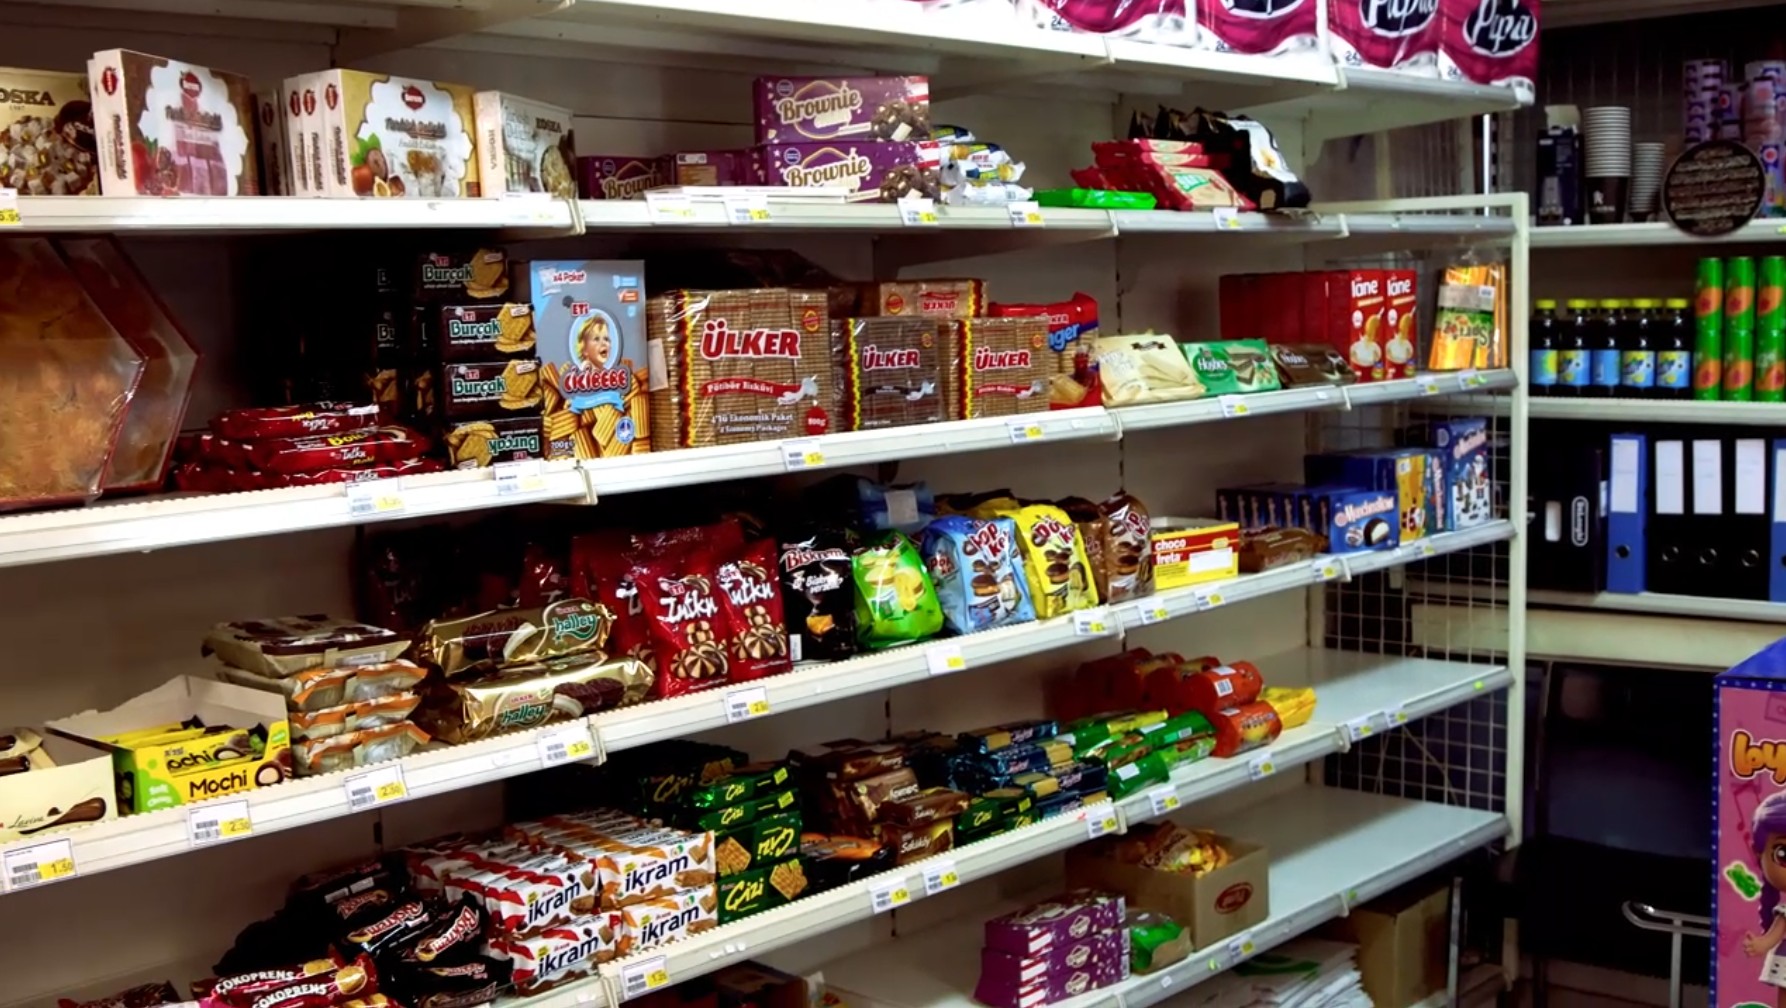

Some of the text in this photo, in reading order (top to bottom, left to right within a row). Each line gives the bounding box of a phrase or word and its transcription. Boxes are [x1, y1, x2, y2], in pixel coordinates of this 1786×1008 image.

[777, 88, 861, 122] Brownie
[786, 158, 871, 187] Brownie
[423, 264, 472, 283] Burçak
[449, 318, 502, 338] Burçak
[700, 318, 801, 359] ÜLKER
[862, 344, 920, 370] ÜLKER
[974, 346, 1031, 371] ÜLKER
[453, 376, 506, 397] Burçak
[488, 435, 540, 455] Burçak
[1155, 537, 1187, 552] choco
[785, 549, 846, 572] Biskrem
[552, 613, 597, 635] halley
[503, 703, 546, 725] halley
[189, 769, 248, 798] Mochi
[624, 855, 688, 893] ikram
[528, 882, 580, 924] ikram
[365, 902, 424, 938] Biskrem
[429, 906, 480, 955] Biskrem
[641, 905, 700, 945] ikram
[539, 936, 599, 978] ikram
